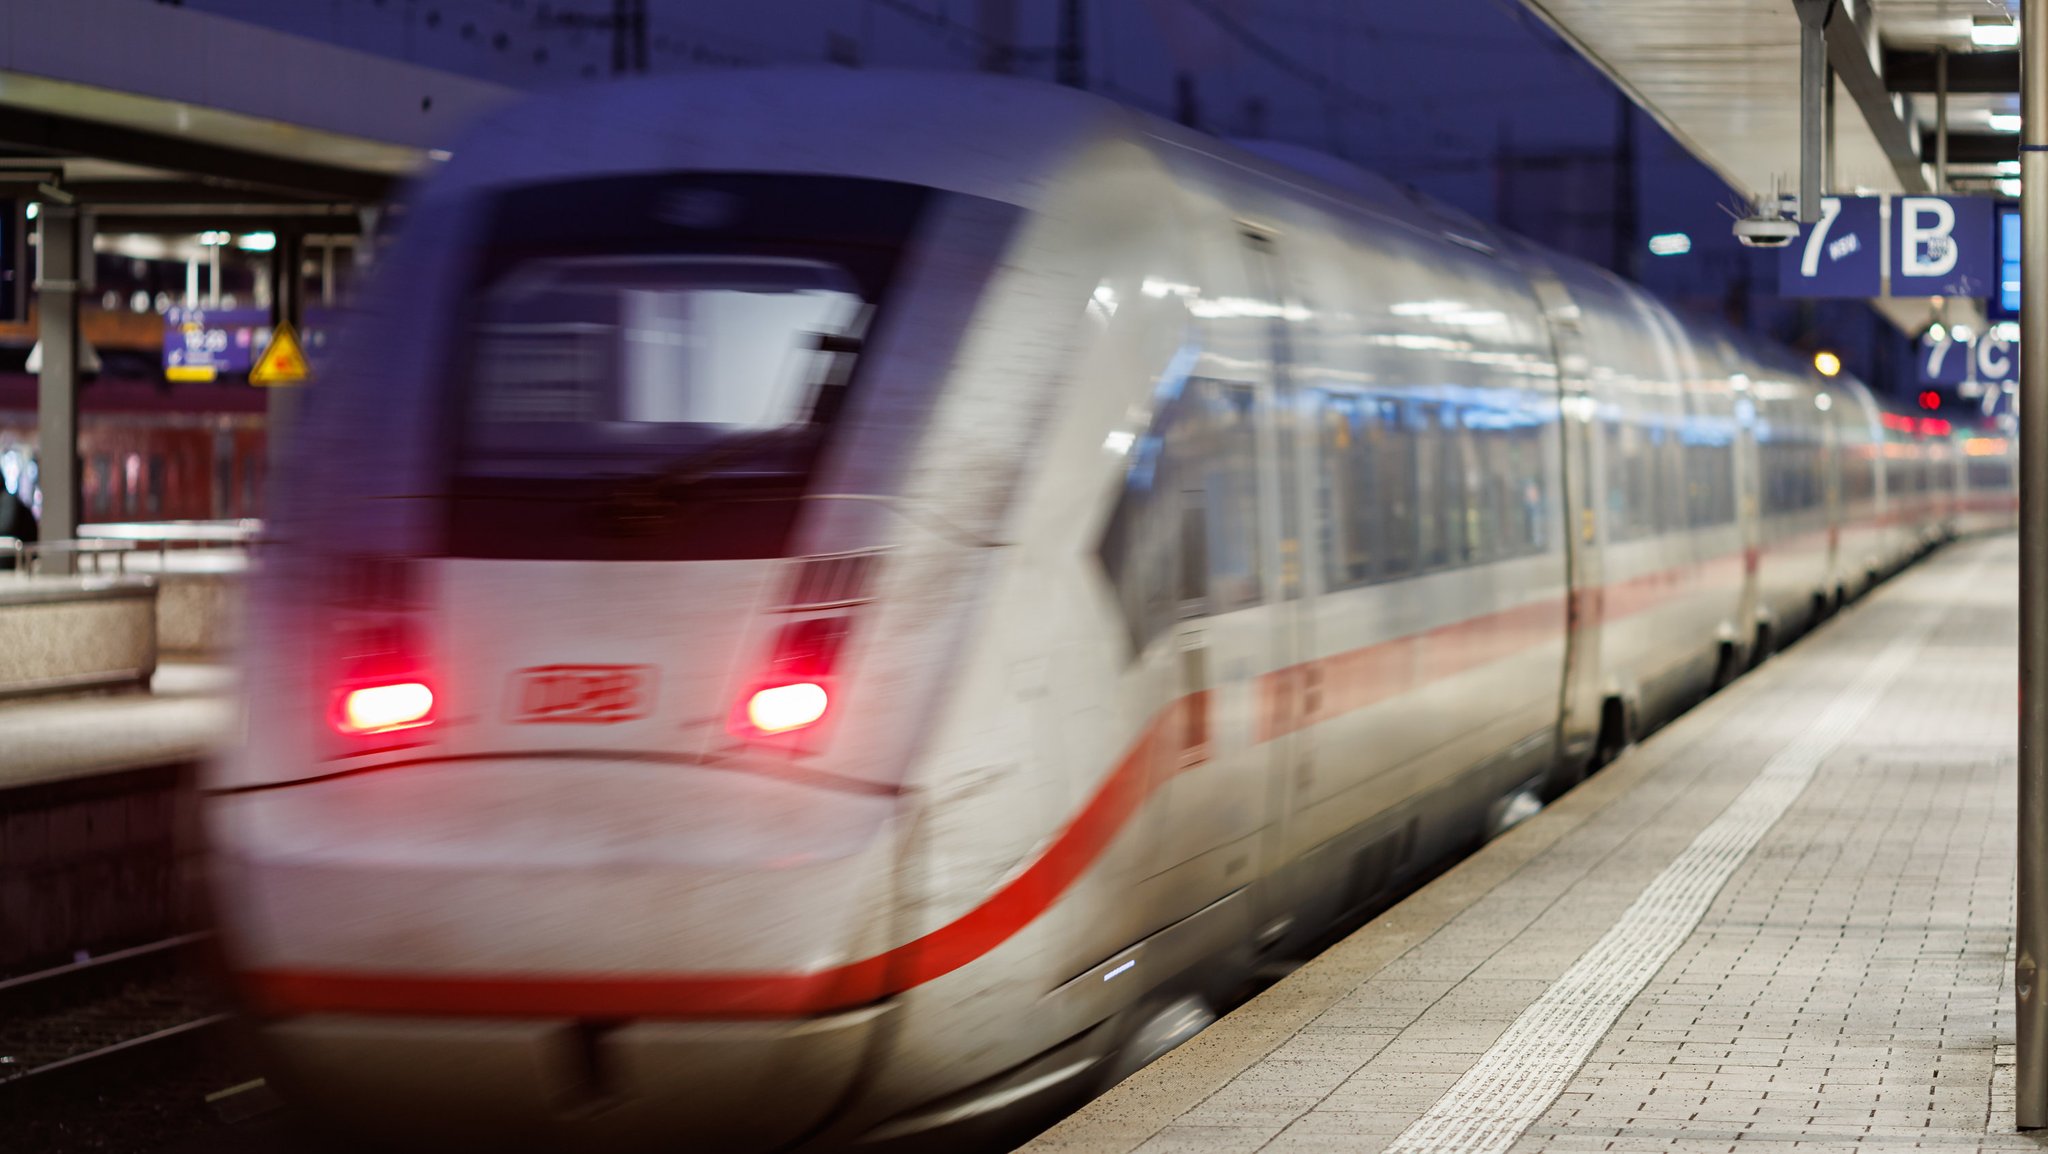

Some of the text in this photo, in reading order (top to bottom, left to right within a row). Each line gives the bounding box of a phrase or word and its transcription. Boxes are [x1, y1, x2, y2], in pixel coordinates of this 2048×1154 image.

[1795, 197, 1842, 277] 7
[1902, 197, 1958, 277] B
[1922, 333, 1952, 379] 7
[1978, 333, 2011, 379] C
